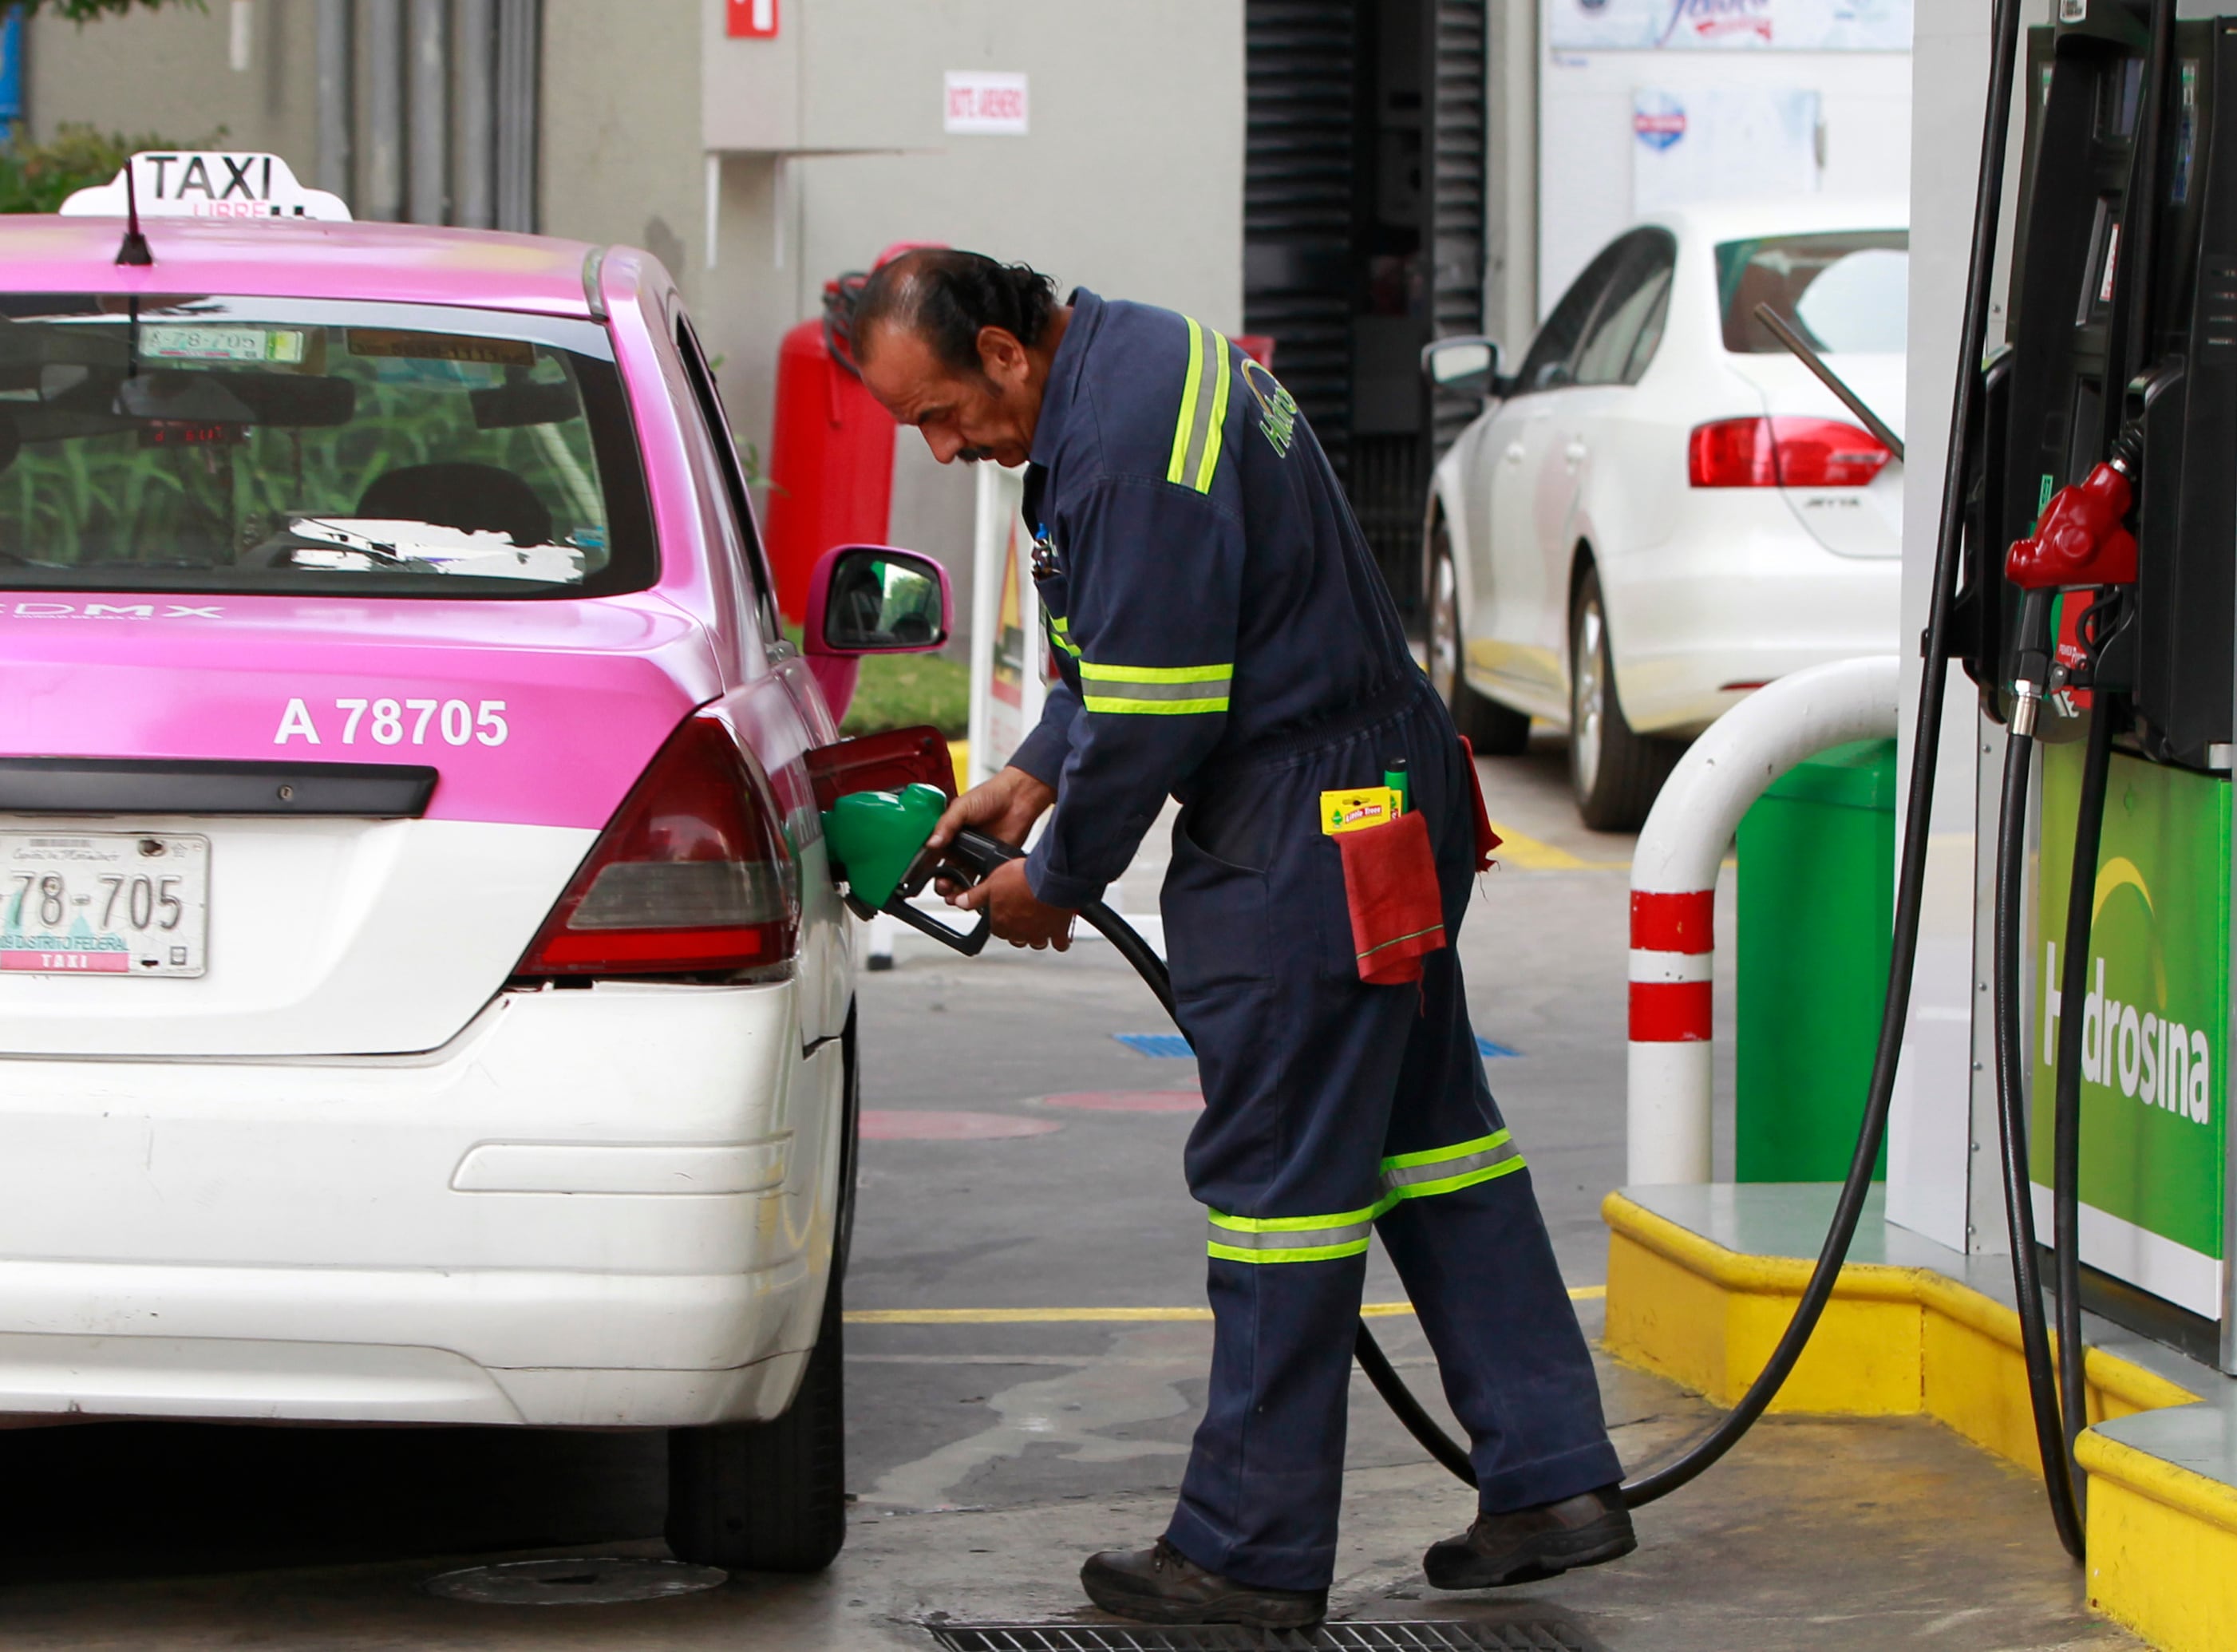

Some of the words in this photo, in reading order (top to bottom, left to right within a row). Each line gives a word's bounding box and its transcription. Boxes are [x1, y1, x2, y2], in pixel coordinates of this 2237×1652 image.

[145, 156, 271, 200] TAXI
[0, 603, 226, 619] DMX
[273, 698, 322, 745] A
[335, 698, 509, 746] 78705
[0, 869, 183, 931] 78-705
[41, 954, 88, 968] TAXI
